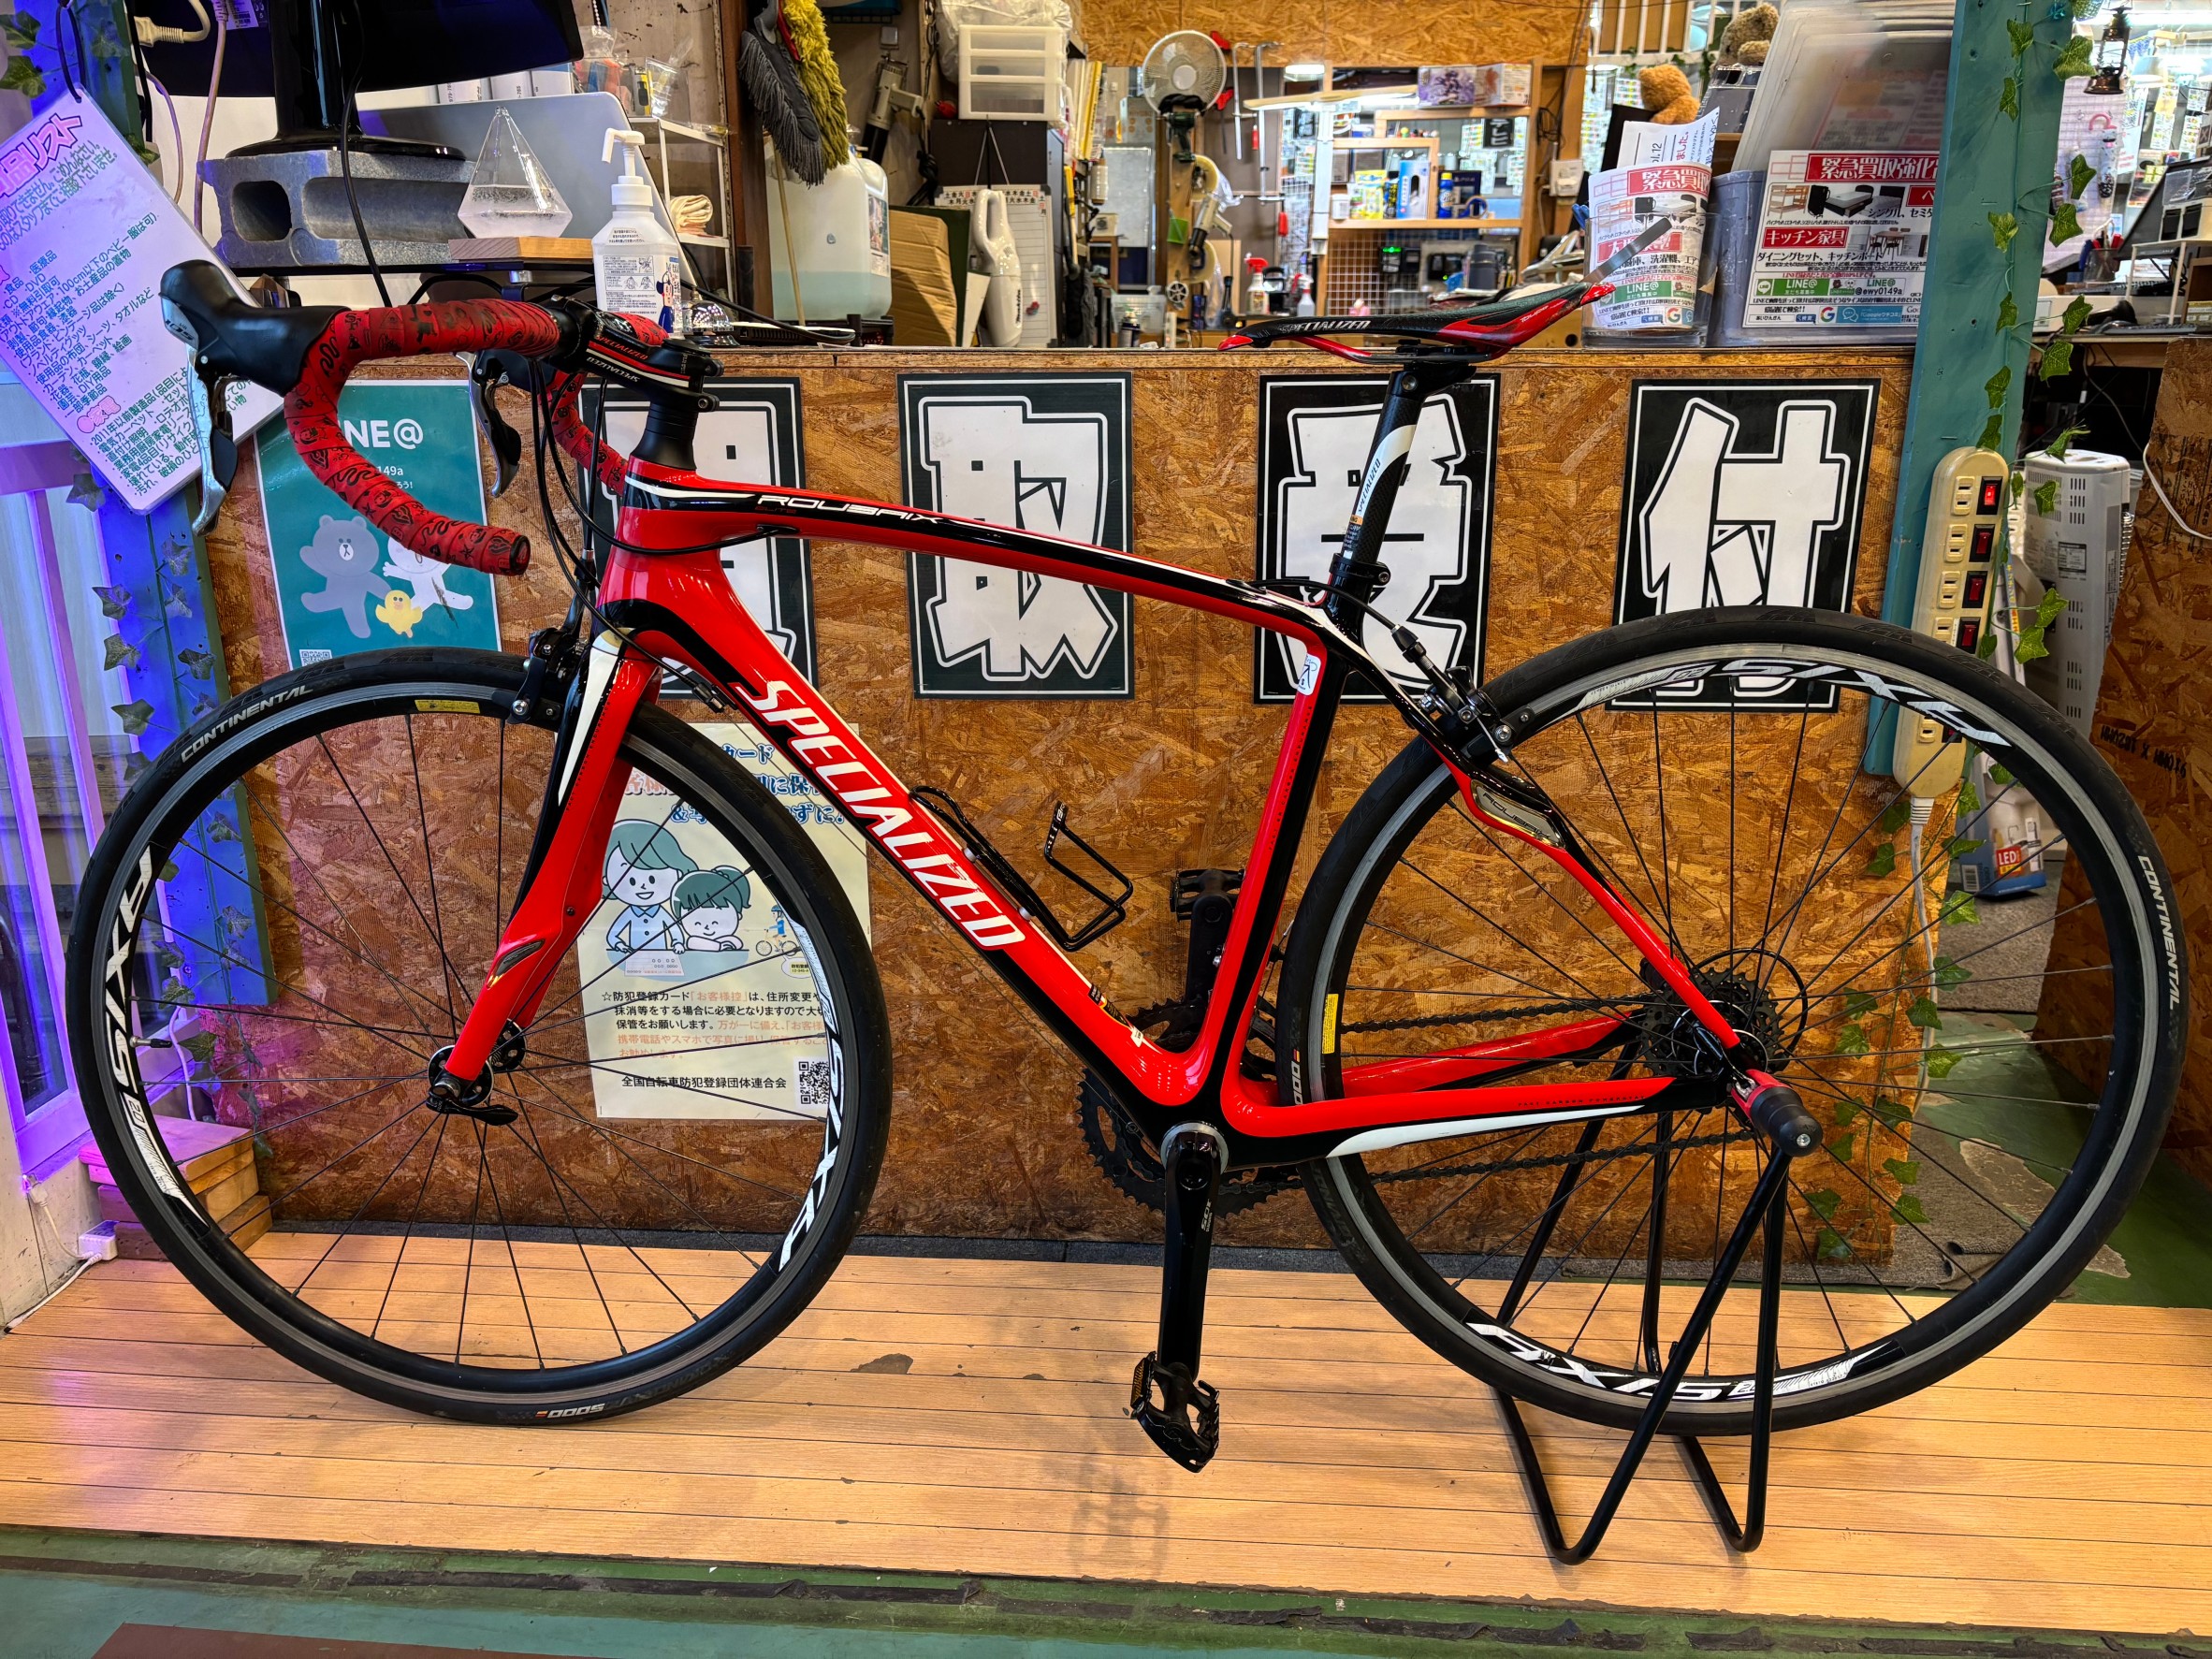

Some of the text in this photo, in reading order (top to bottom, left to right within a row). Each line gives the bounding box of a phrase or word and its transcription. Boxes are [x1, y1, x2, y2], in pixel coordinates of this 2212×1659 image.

[1766, 228, 1845, 245] キッチン家具
[1786, 279, 1817, 288] LINE@
[1855, 286, 1902, 296] @ewy0149a
[1867, 279, 1896, 287] LINE@
[596, 336, 648, 360] SPECIALIZED
[587, 357, 641, 382] SPECIALIZED
[1359, 458, 1382, 513] SPECIALIZED
[757, 495, 939, 524] ROUBAIX
[181, 685, 313, 764] CONTINENTAL
[735, 680, 1026, 947] SPECIALIZED
[1998, 850, 2017, 866] LED
[2137, 855, 2180, 1011] CONTINENTAL
[621, 1076, 787, 1089] 全国自転車防犯登録団体連合会
[547, 1403, 605, 1419] 5000
